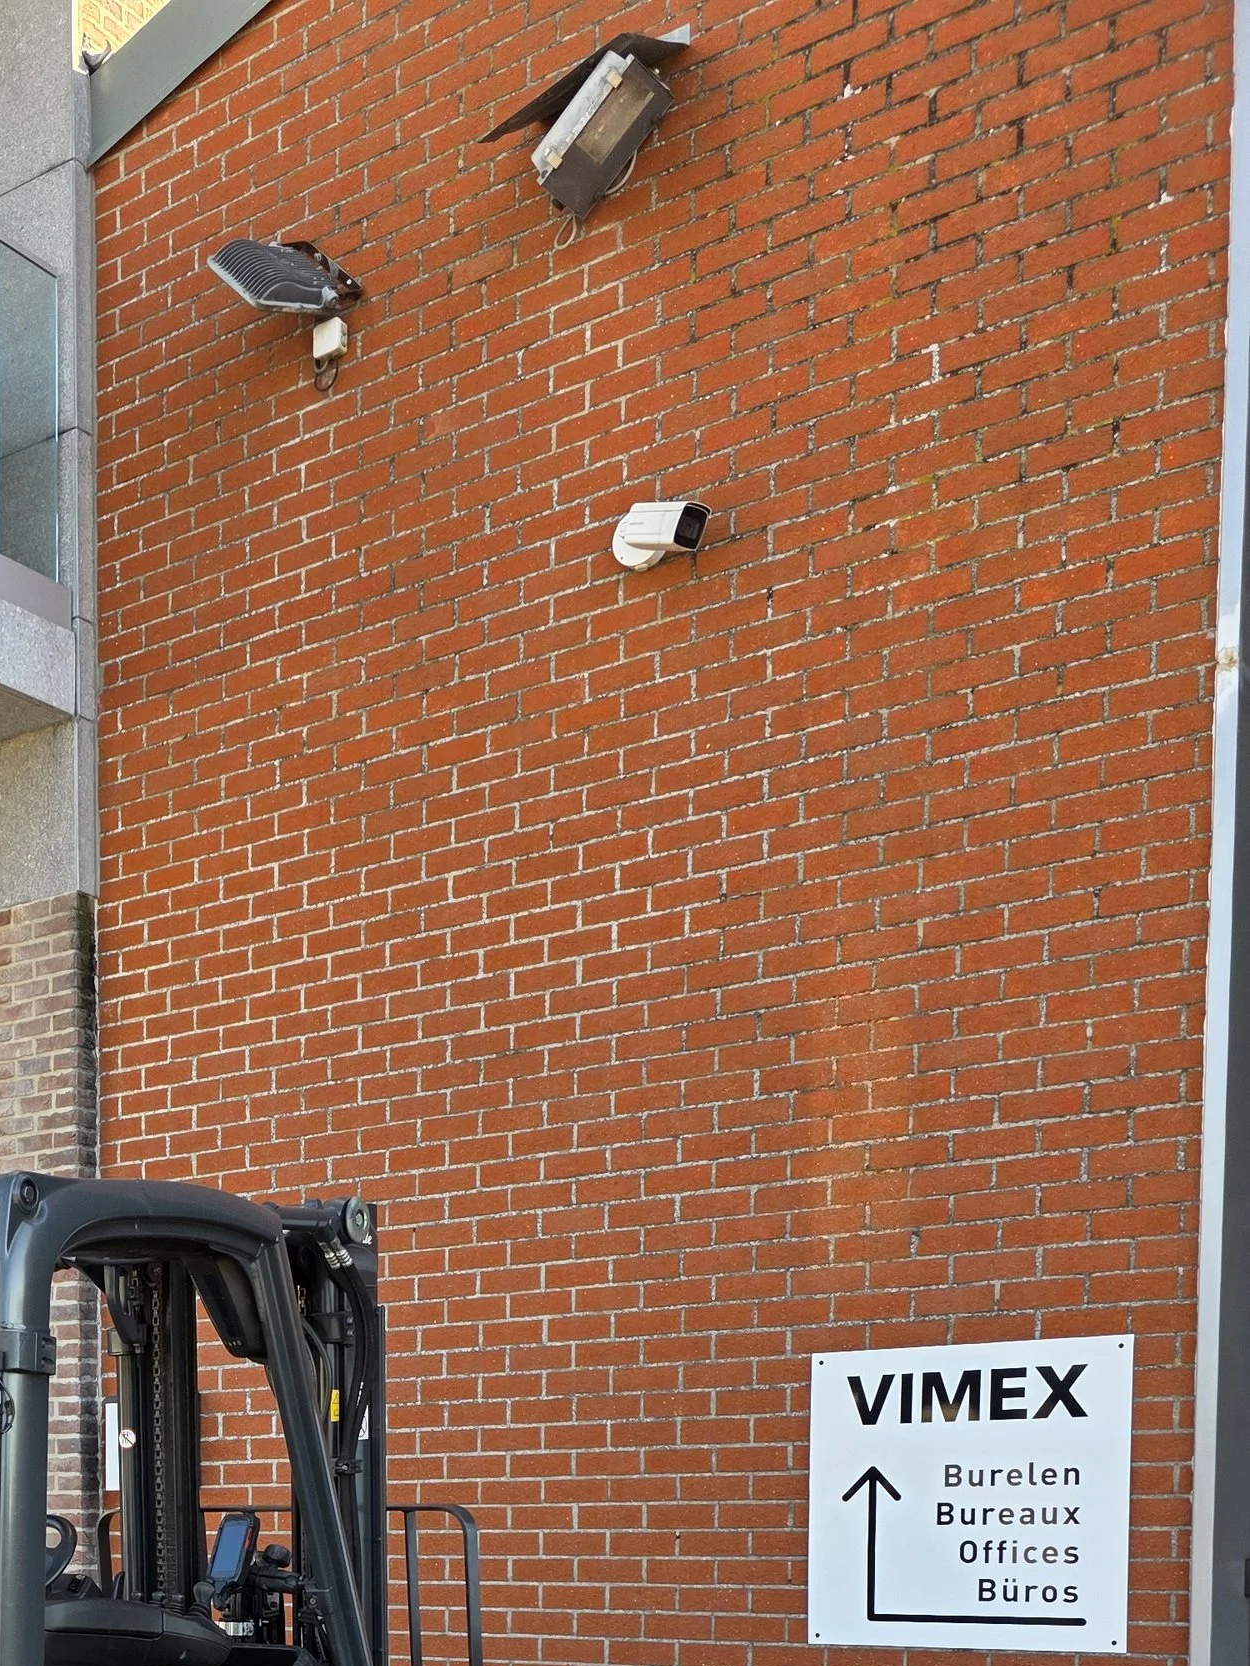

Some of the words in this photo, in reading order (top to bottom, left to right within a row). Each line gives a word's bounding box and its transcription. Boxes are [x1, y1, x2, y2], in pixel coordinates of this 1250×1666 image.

[847, 1364, 1089, 1426] VIMEX
[944, 1462, 1080, 1488] Burelen
[936, 1502, 1081, 1526] Bureaux
[959, 1540, 1080, 1564] Offices
[978, 1578, 1079, 1603] Büros
